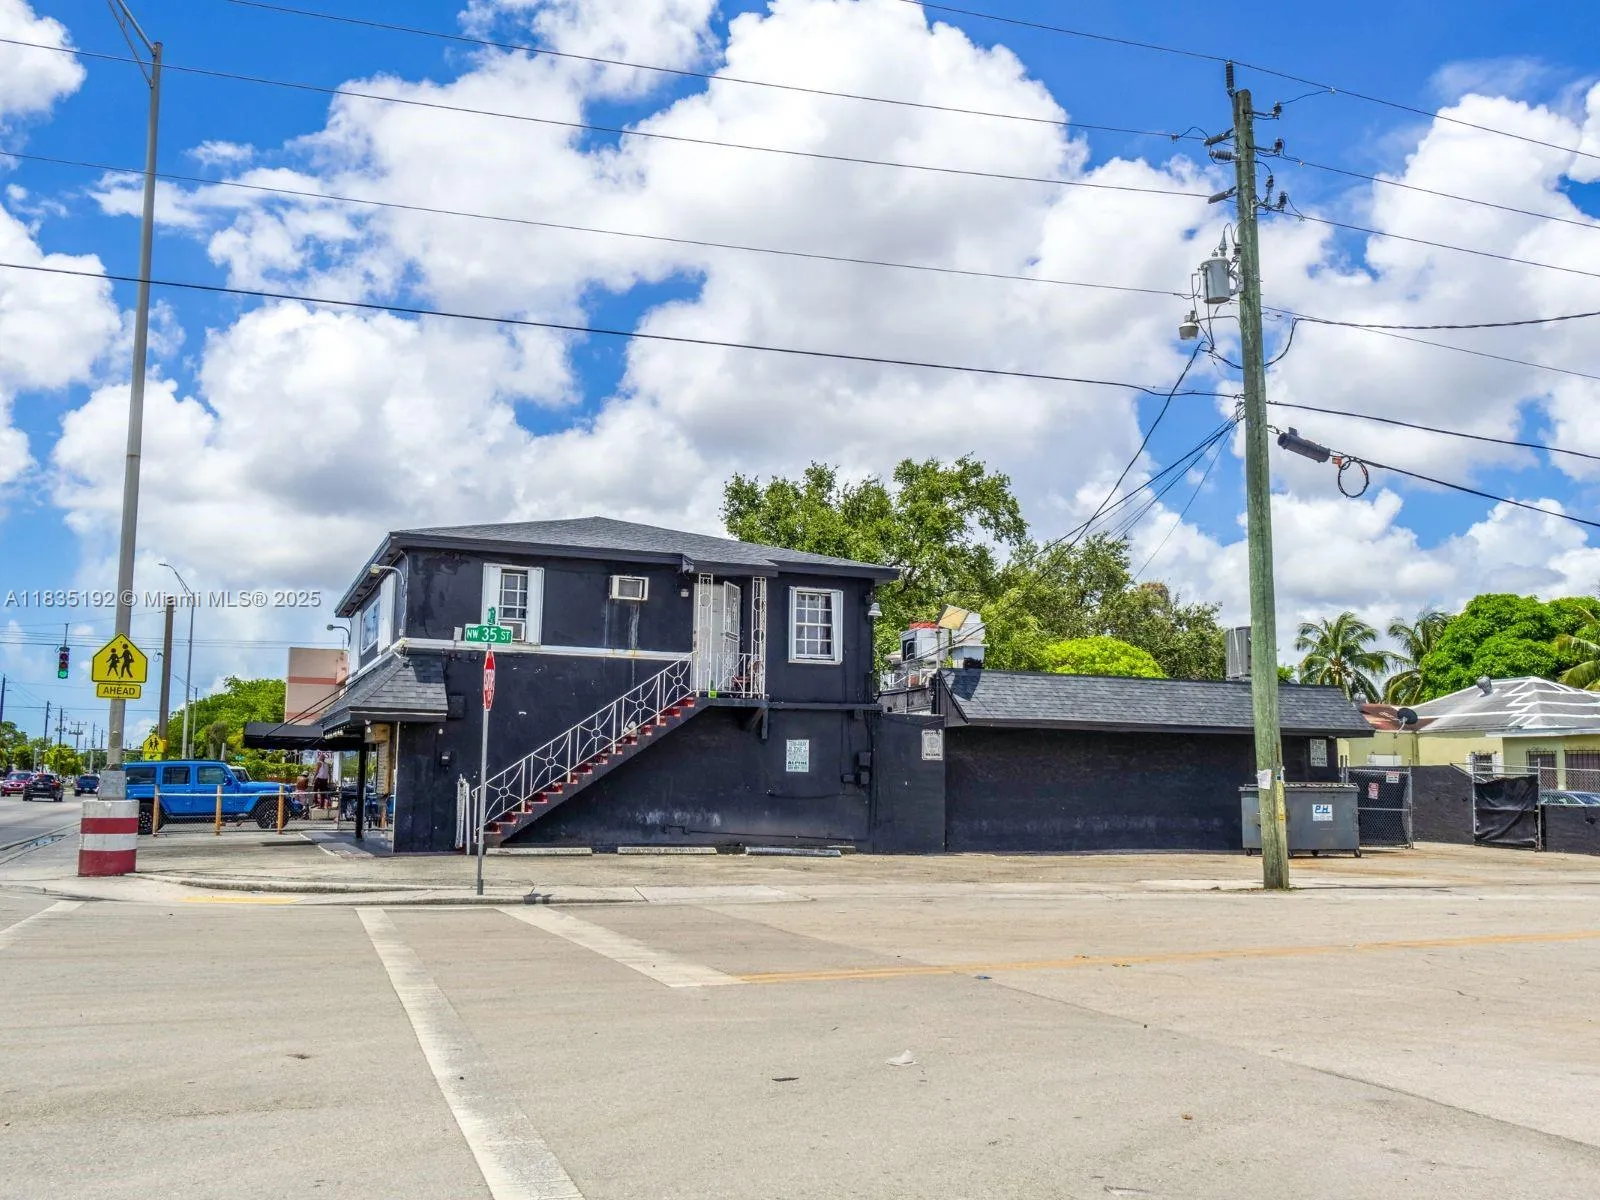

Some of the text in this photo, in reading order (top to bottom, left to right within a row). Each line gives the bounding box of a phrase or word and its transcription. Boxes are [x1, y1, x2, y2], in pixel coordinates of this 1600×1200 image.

[466, 627, 511, 641] NW 35 ST
[103, 686, 136, 696] AHEAD
